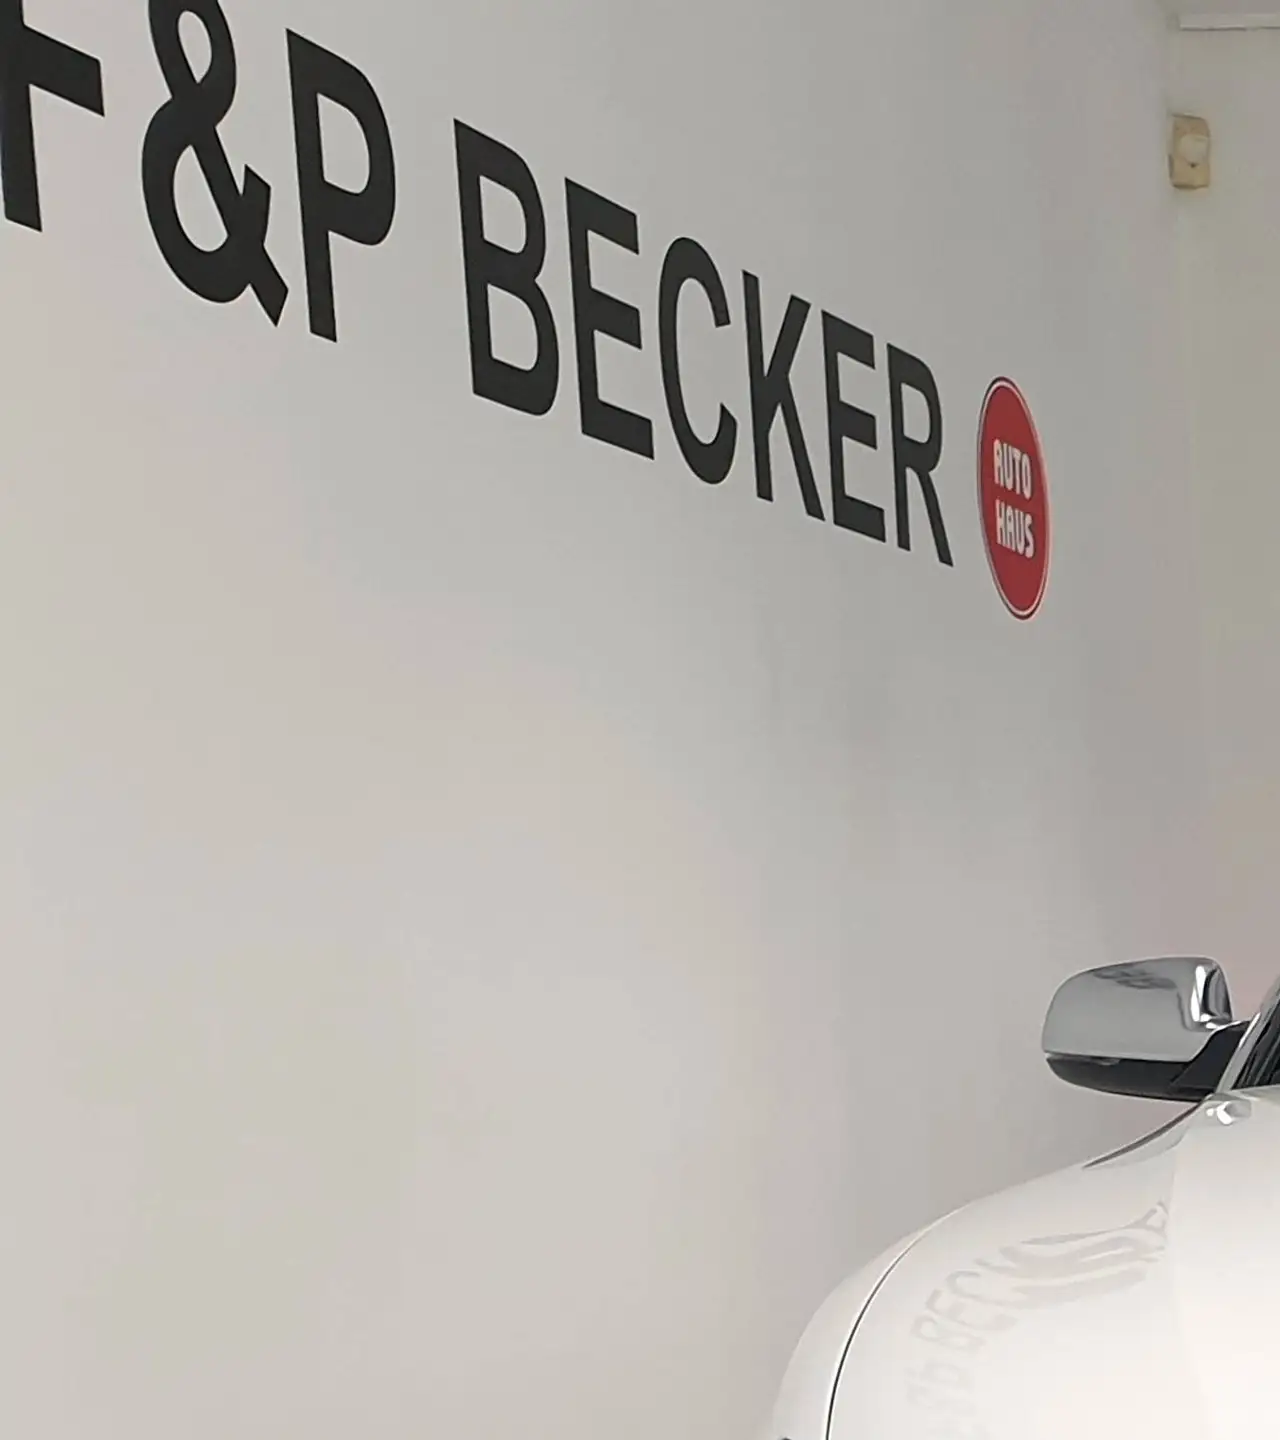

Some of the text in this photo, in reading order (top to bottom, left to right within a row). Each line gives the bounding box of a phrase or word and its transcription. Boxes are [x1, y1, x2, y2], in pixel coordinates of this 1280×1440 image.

[453, 118, 954, 568] BECKER
[993, 438, 1032, 499] AUTO
[995, 499, 1035, 558] HAUS
